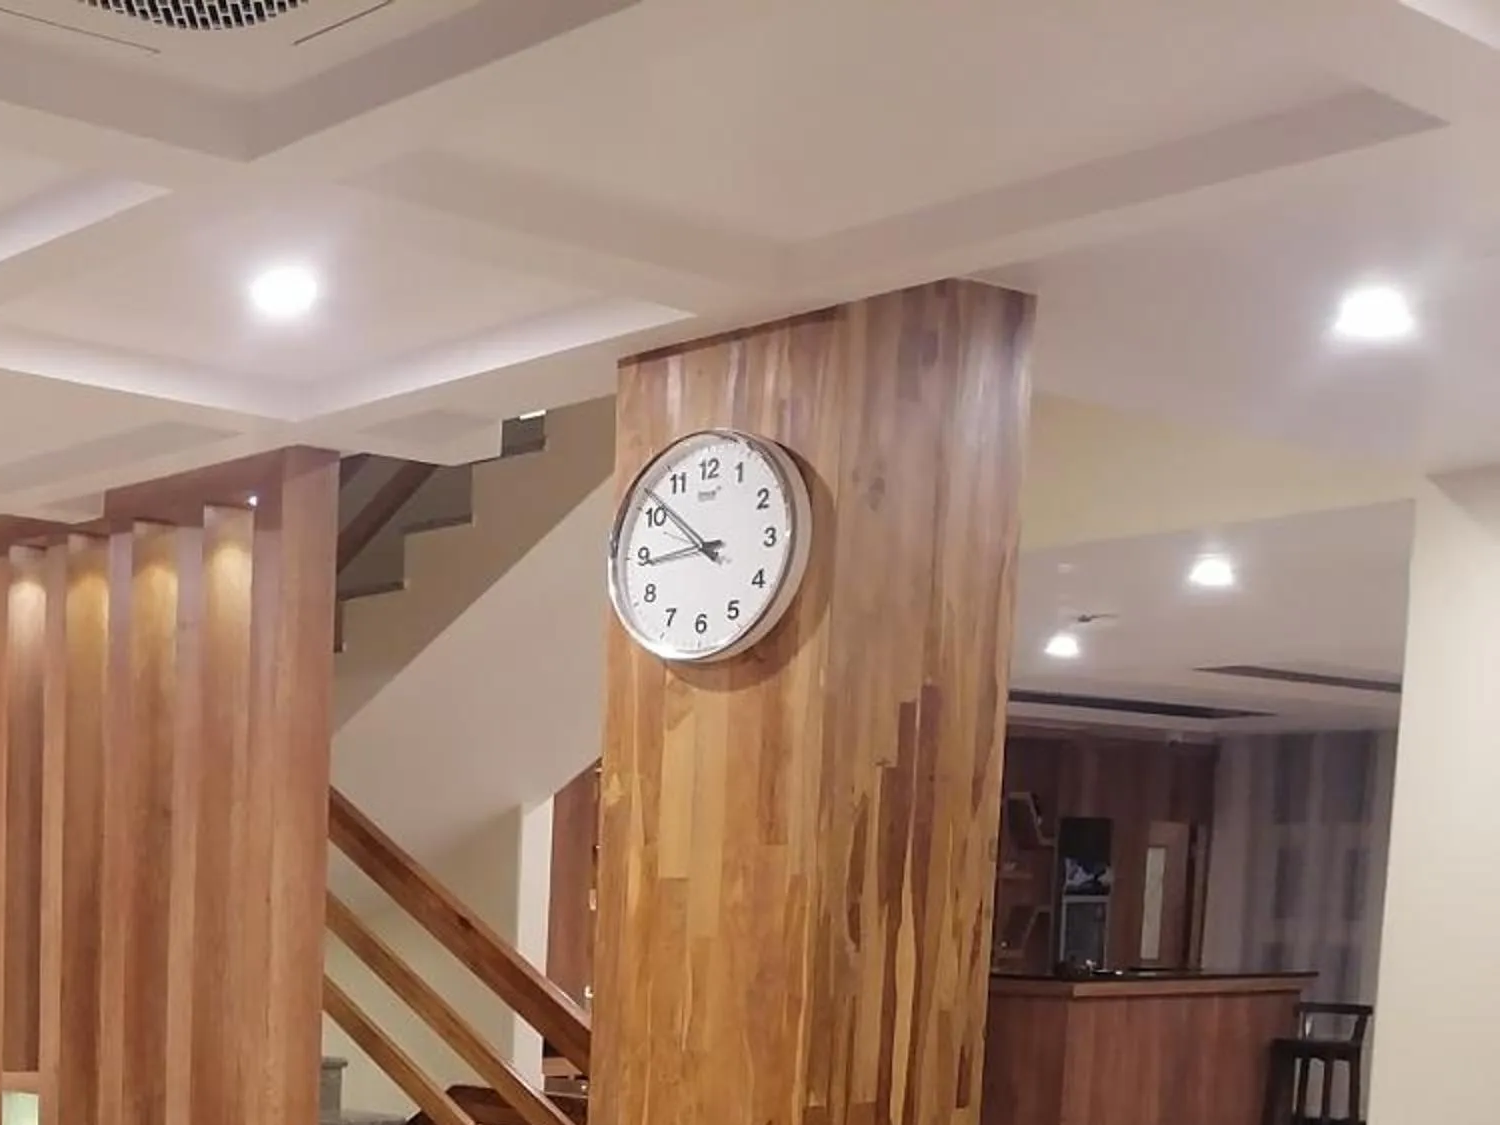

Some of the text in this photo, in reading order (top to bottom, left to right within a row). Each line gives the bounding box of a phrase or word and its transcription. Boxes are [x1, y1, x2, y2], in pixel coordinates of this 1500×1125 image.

[699, 458, 720, 481] 12
[735, 462, 745, 484] 1
[670, 472, 688, 495] 11
[756, 488, 770, 510] 2
[646, 506, 668, 528] 10
[763, 527, 777, 548] 3
[637, 547, 651, 567] 9
[751, 568, 766, 589] 4
[643, 584, 657, 603] 8
[665, 608, 677, 628] 7
[727, 600, 740, 620] 5
[695, 614, 708, 634] 6
